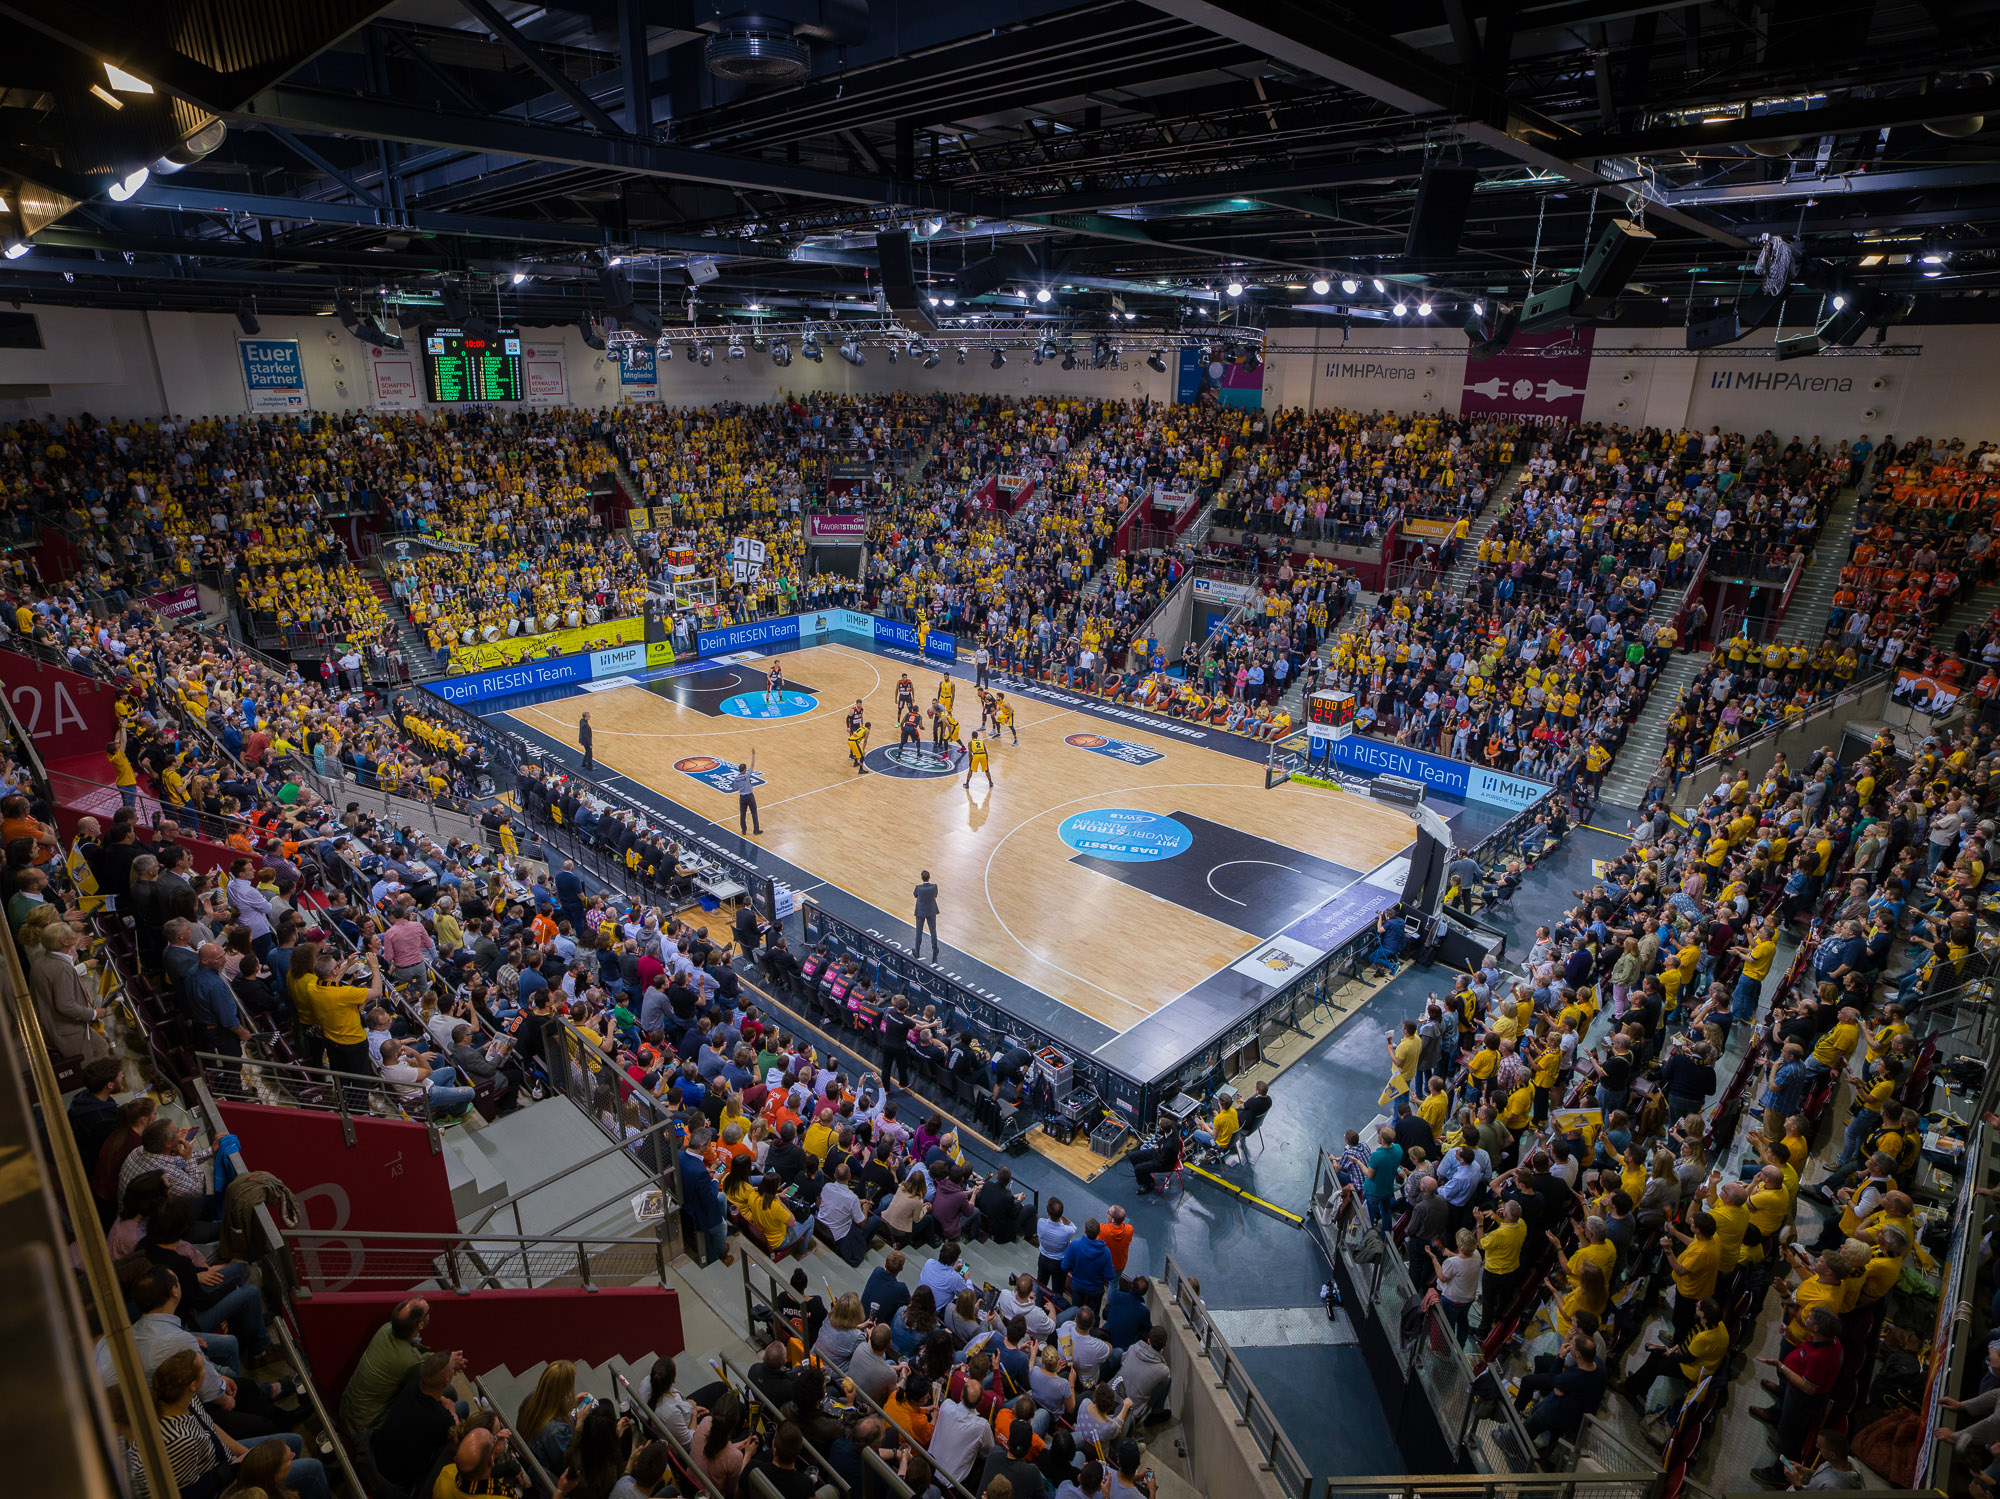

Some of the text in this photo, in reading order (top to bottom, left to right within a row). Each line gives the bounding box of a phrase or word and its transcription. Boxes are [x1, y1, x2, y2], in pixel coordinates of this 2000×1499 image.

[465, 340, 485, 348] 10:00
[246, 345, 293, 361] Euer
[250, 362, 295, 373] starker
[1341, 363, 1416, 380] MHPArena
[251, 374, 297, 384] Partner
[1735, 372, 1853, 392] MHPArena
[1211, 583, 1238, 591] Volksbank
[853, 615, 869, 628] MHP
[700, 623, 800, 651] Dein RIESEN Team.
[875, 623, 894, 638] Dein
[928, 635, 954, 654] Team.
[611, 649, 637, 663] MHP
[442, 664, 577, 701] Dein RIESEN Team.
[12, 681, 88, 740] 2A
[992, 678, 1207, 739] MHP RIESEN LUDWIGSBURG
[1313, 709, 1333, 723] 24
[1341, 708, 1352, 724] 24
[1354, 745, 1412, 774] RIESEN
[1417, 760, 1467, 789] Team.
[1372, 786, 1414, 800] PORSCHE
[1499, 780, 1538, 800] MHP
[1486, 793, 1509, 803] PORSCHE
[1075, 818, 1128, 830] PUNKTEN
[1109, 813, 1144, 822] SWLB
[1072, 823, 1181, 843] FAVORITSTROM
[1079, 840, 1159, 855] DAS PASST!
[1155, 840, 1178, 848] MIT
[391, 1164, 404, 1179] A3
[295, 1182, 366, 1293] B
